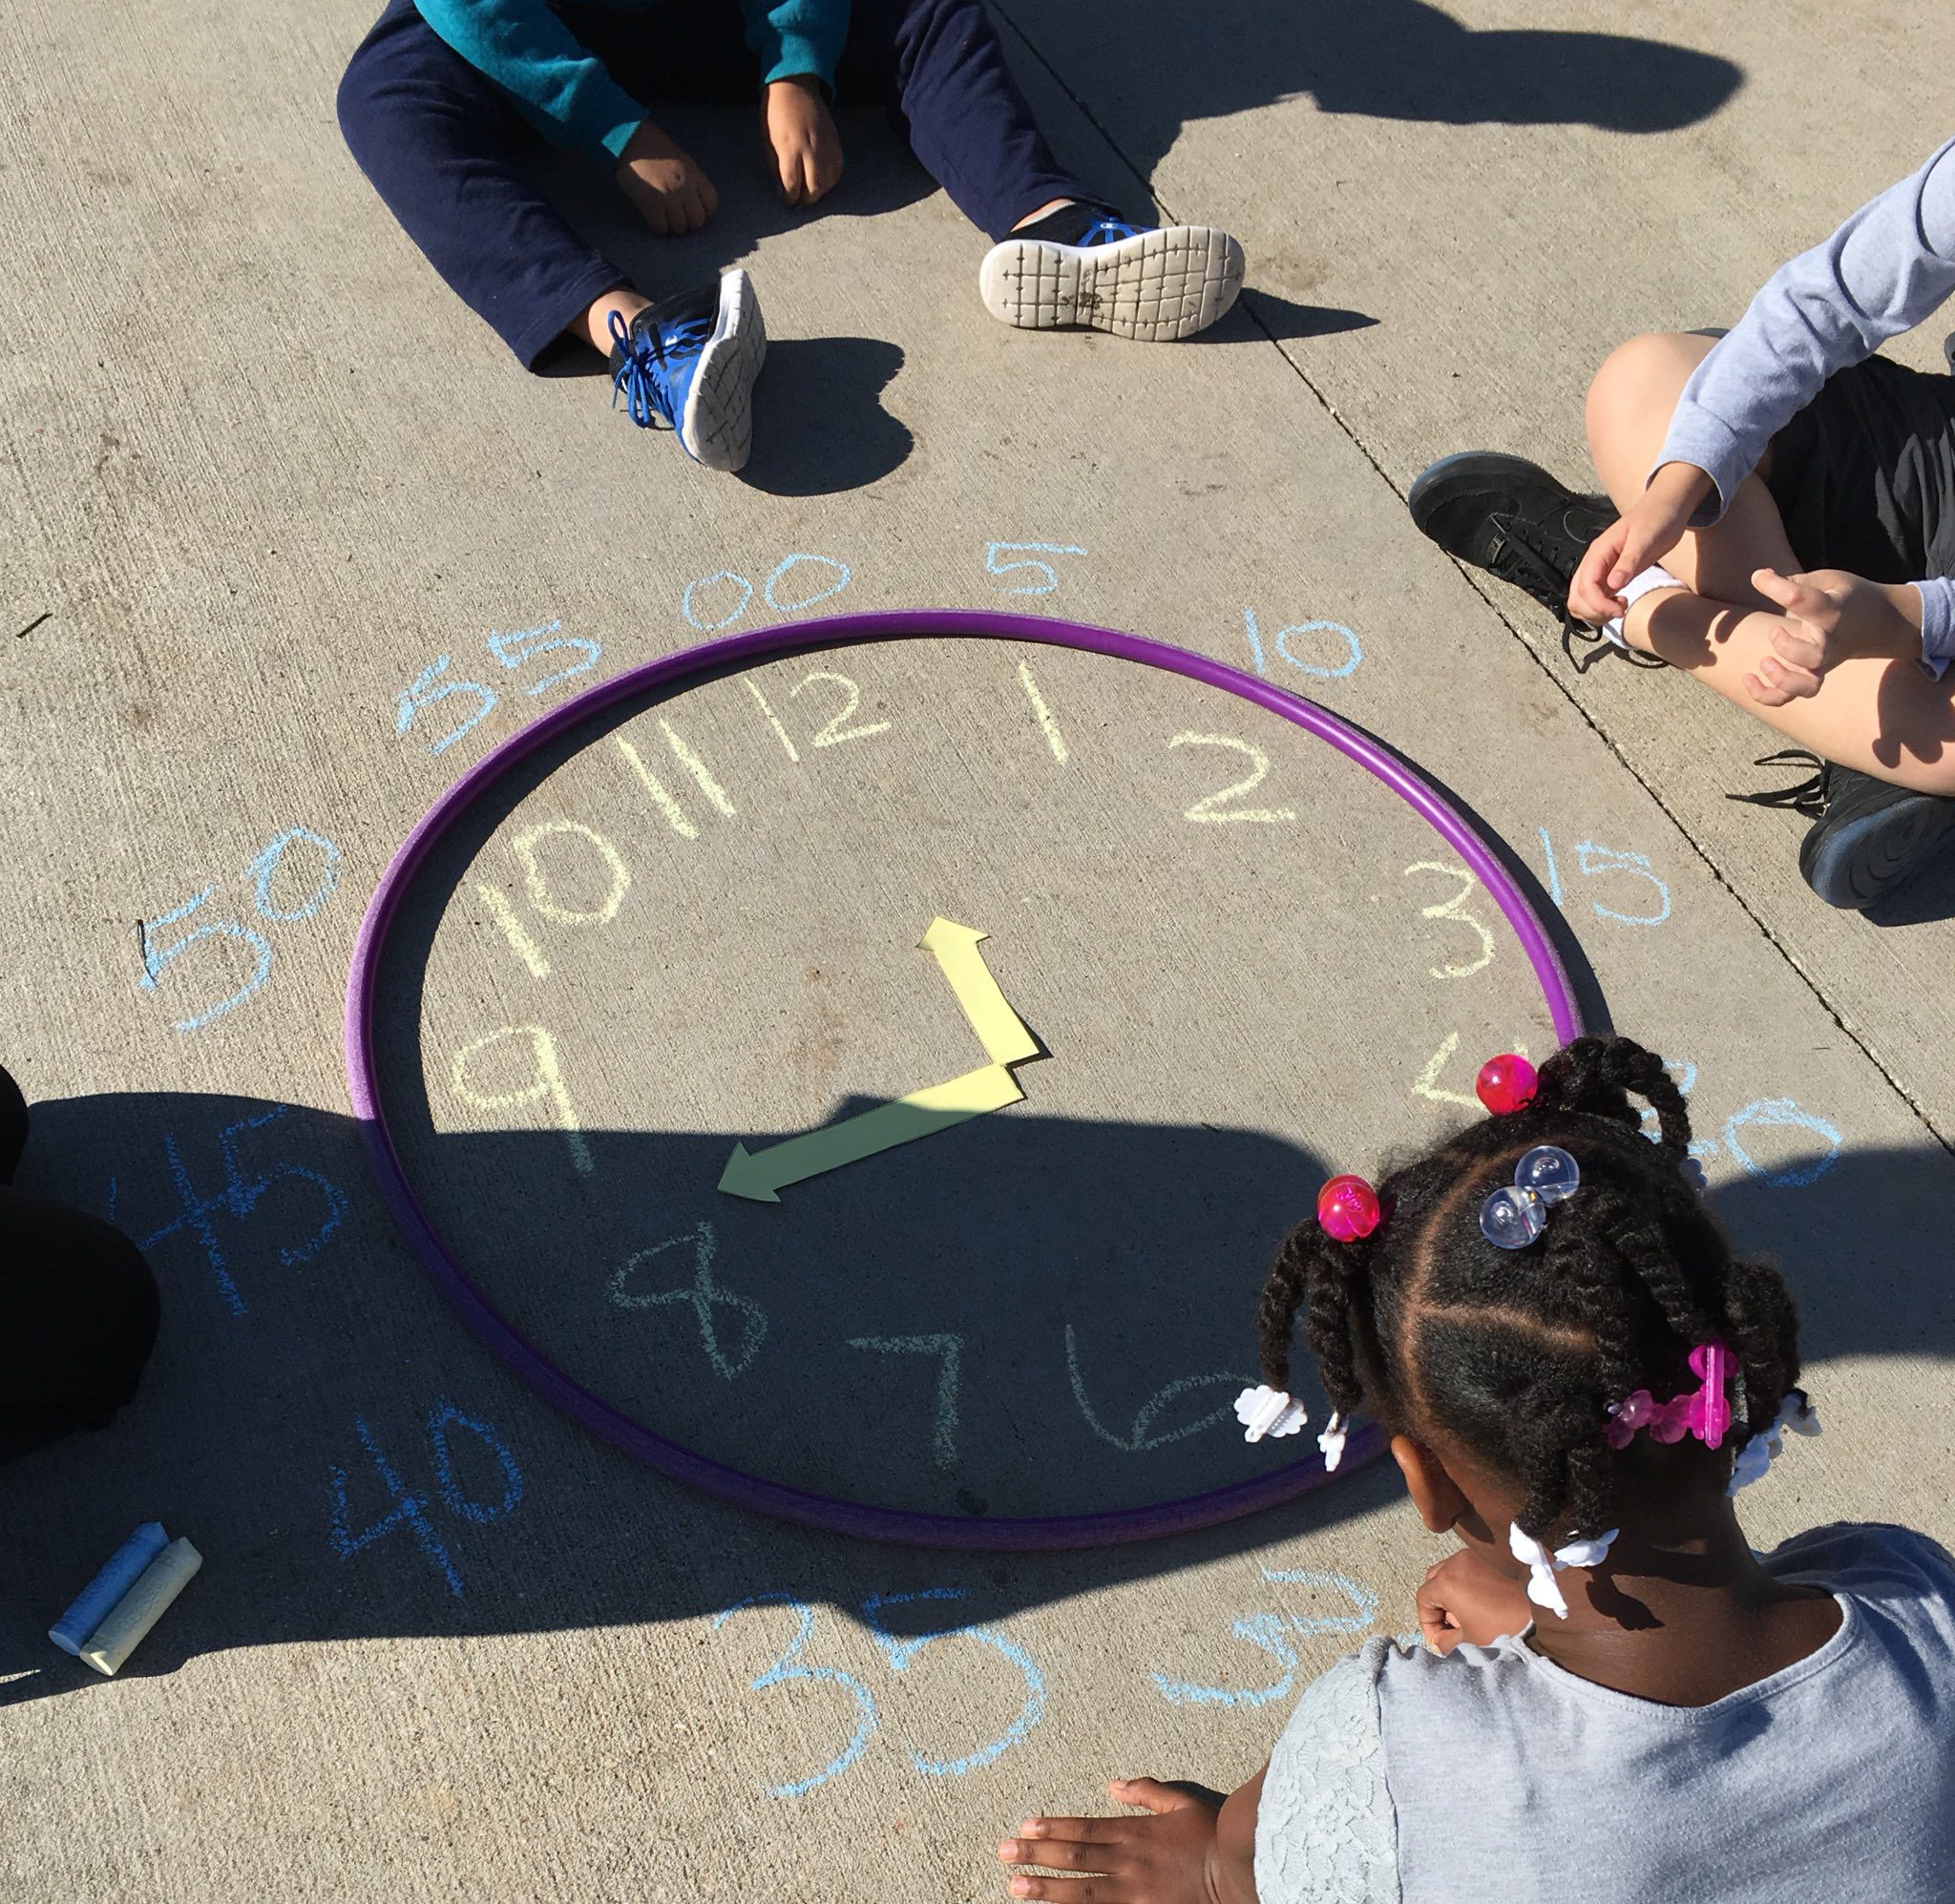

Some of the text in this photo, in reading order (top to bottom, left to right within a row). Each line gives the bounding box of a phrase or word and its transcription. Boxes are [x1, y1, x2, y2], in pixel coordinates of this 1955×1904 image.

[987, 541, 1087, 595] 5
[396, 619, 603, 756] 55
[1243, 605, 1363, 678] 10
[616, 718, 736, 840] 11
[745, 671, 892, 762] 12
[1019, 662, 1068, 764] 1
[1167, 730, 1296, 825] 2
[137, 826, 341, 1033] 50
[477, 818, 631, 977] 10
[1404, 861, 1495, 980] 3
[1539, 826, 1671, 928] 15
[451, 1025, 596, 1177] 9
[108, 1103, 348, 1317] 45
[606, 1221, 767, 1380] 8
[846, 1332, 963, 1471] 7
[1064, 1324, 1266, 1452] 6
[330, 1398, 524, 1600] 40
[711, 1586, 1048, 1799] 35
[1148, 1567, 1424, 1707] 3
